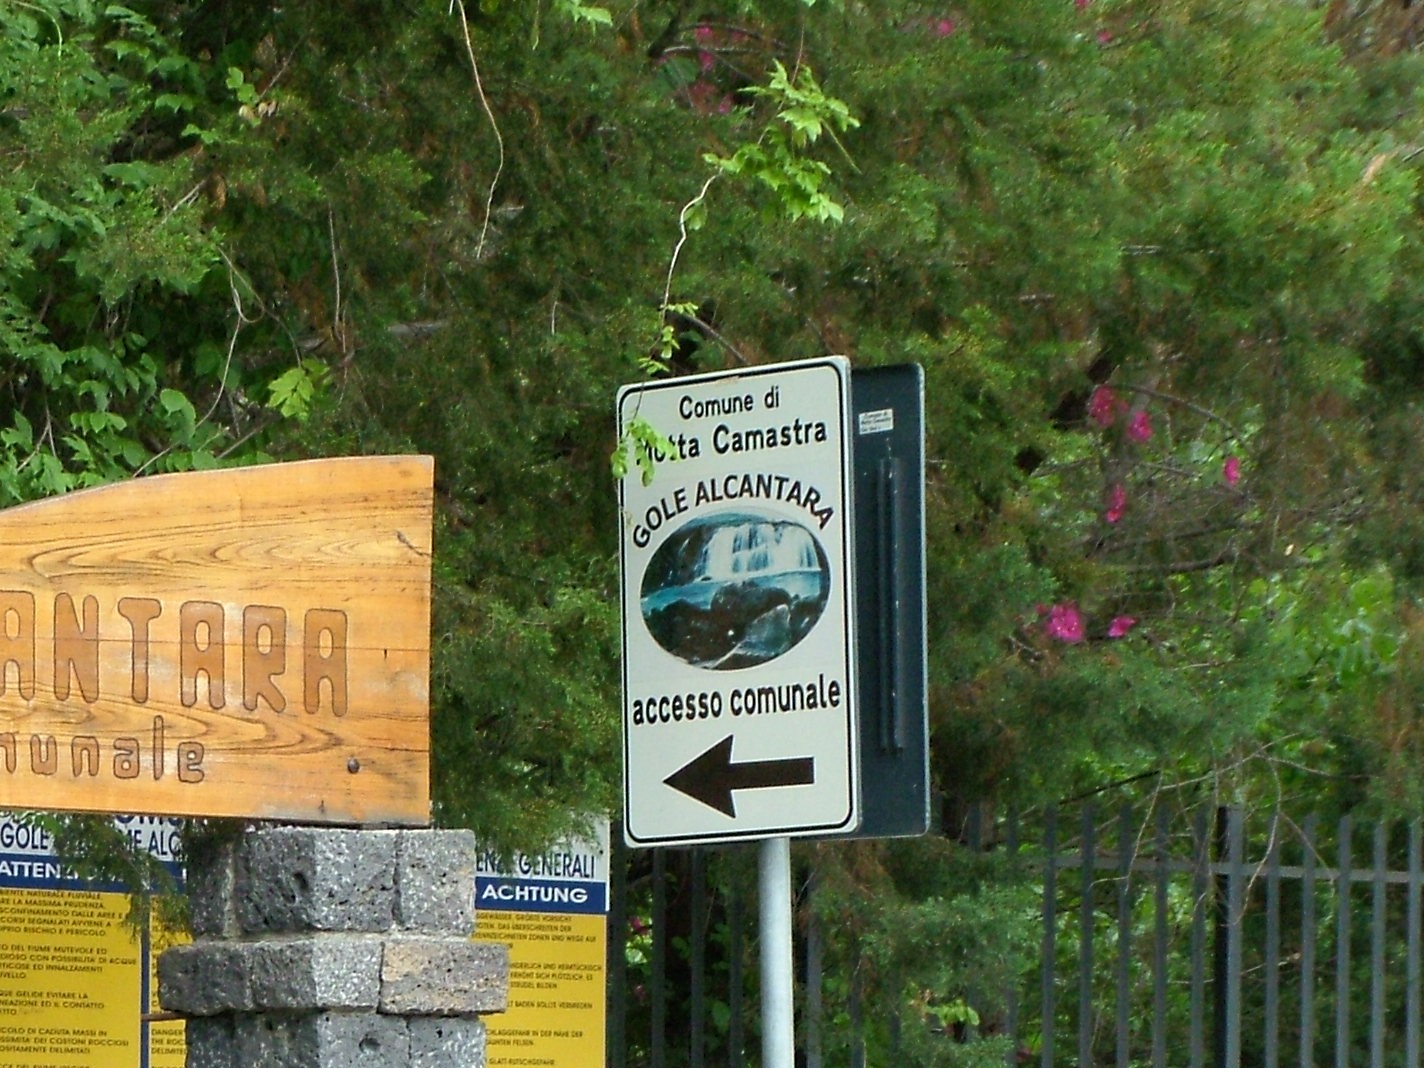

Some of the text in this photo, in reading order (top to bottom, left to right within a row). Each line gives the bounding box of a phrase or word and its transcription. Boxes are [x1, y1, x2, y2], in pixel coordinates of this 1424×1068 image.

[679, 385, 780, 420] Comune di
[712, 417, 827, 454] Camastra
[632, 473, 835, 548] GOLE ALCANTARA
[632, 673, 841, 726] accesso comunale
[0, 822, 49, 851] GOLE
[482, 884, 588, 904] ACHTUNG
